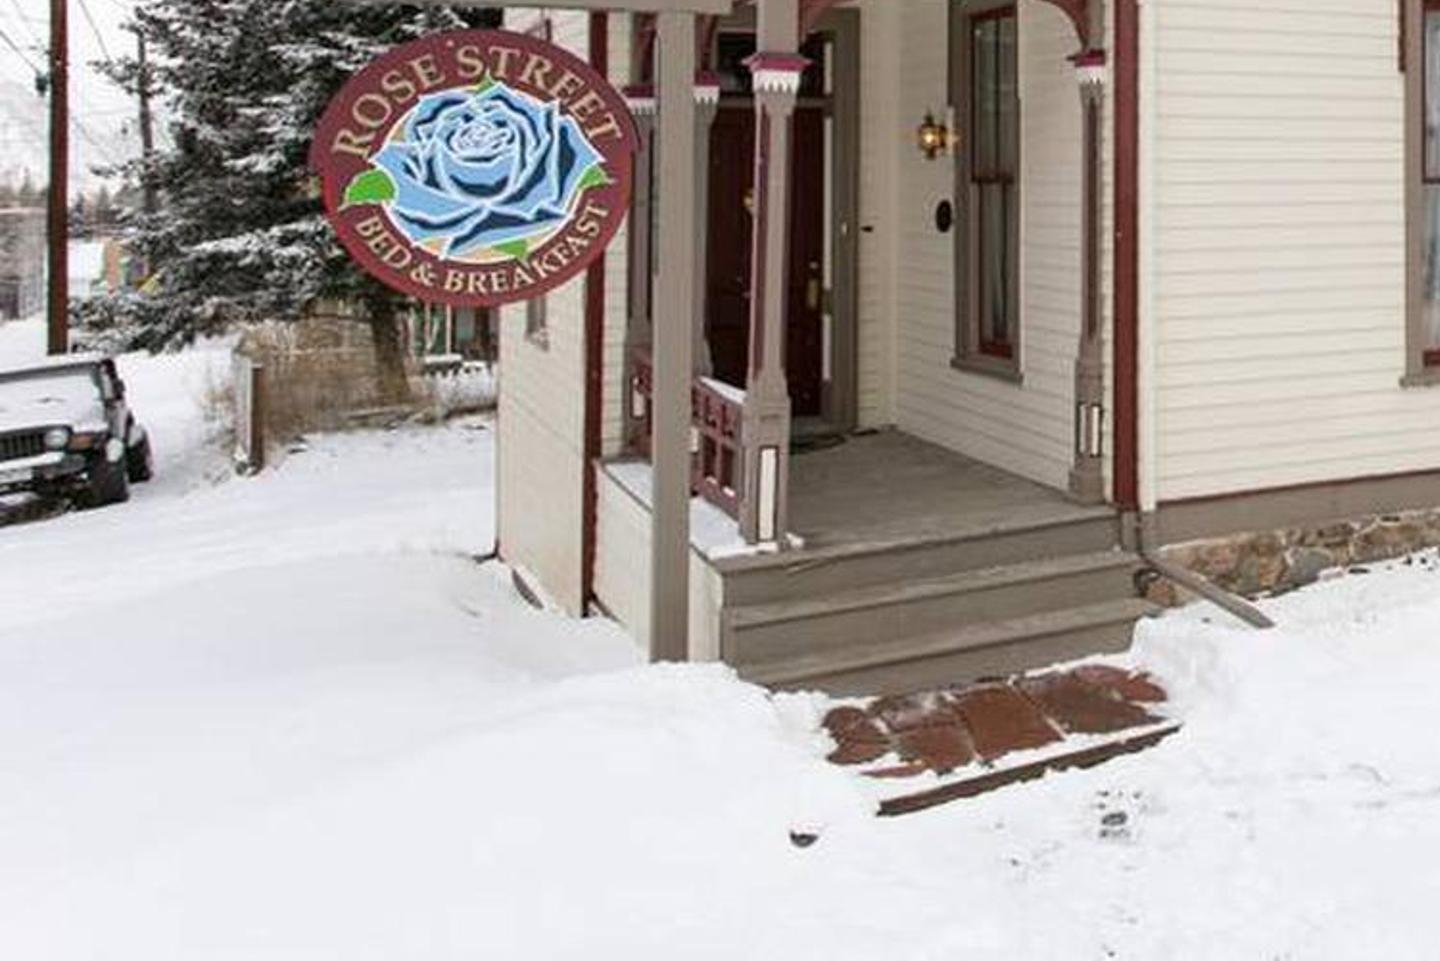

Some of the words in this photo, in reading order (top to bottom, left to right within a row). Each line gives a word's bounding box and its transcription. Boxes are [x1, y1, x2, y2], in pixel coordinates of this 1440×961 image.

[331, 54, 446, 159] ROSE
[456, 45, 622, 140] STREET
[355, 215, 412, 269] BED
[410, 263, 437, 286] &
[443, 200, 609, 294] BREAKFAST
